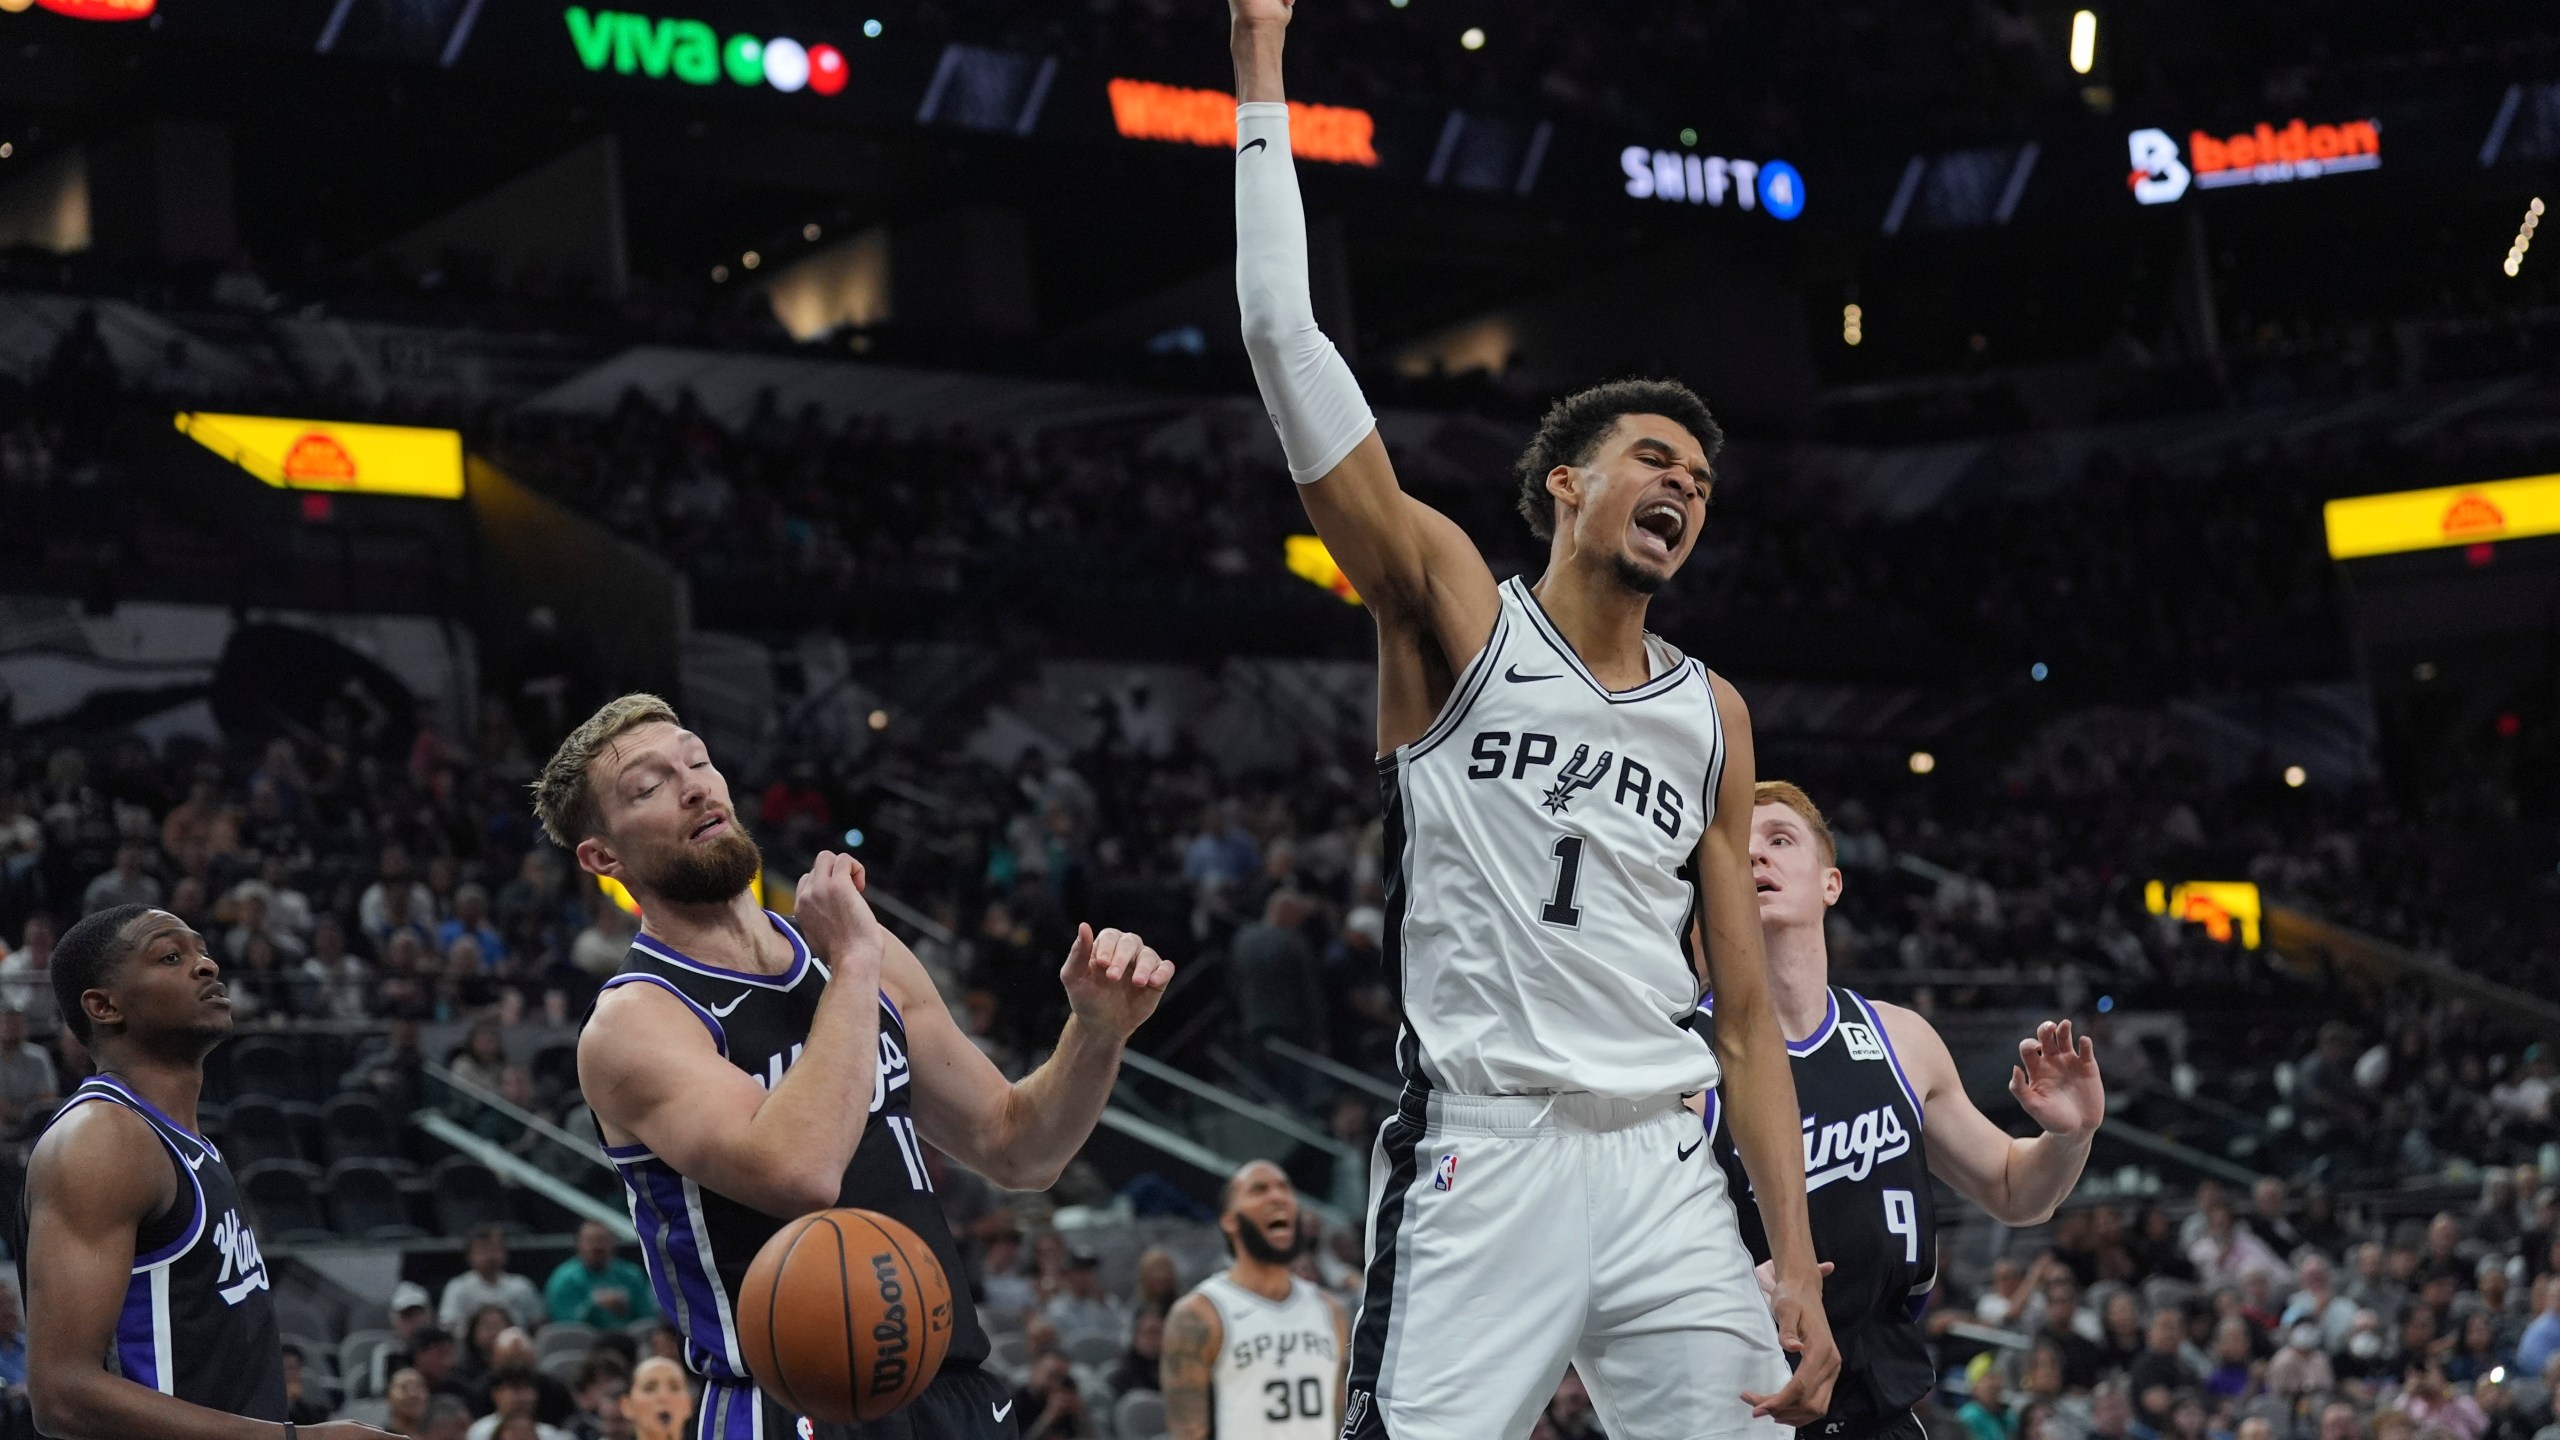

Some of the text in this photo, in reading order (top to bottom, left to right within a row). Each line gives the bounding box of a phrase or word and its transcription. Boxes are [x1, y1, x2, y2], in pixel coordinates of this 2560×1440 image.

[2189, 118, 2380, 174] beldon
[1467, 731, 1684, 840] SPURS
[1537, 832, 1588, 932] 1
[886, 1115, 935, 1193] 11
[1802, 1104, 1911, 1194] ings
[1882, 1189, 1919, 1263] 9
[870, 1252, 910, 1397] Wilson
[1233, 1329, 1336, 1370] SPURS
[1263, 1375, 1323, 1422] 30
